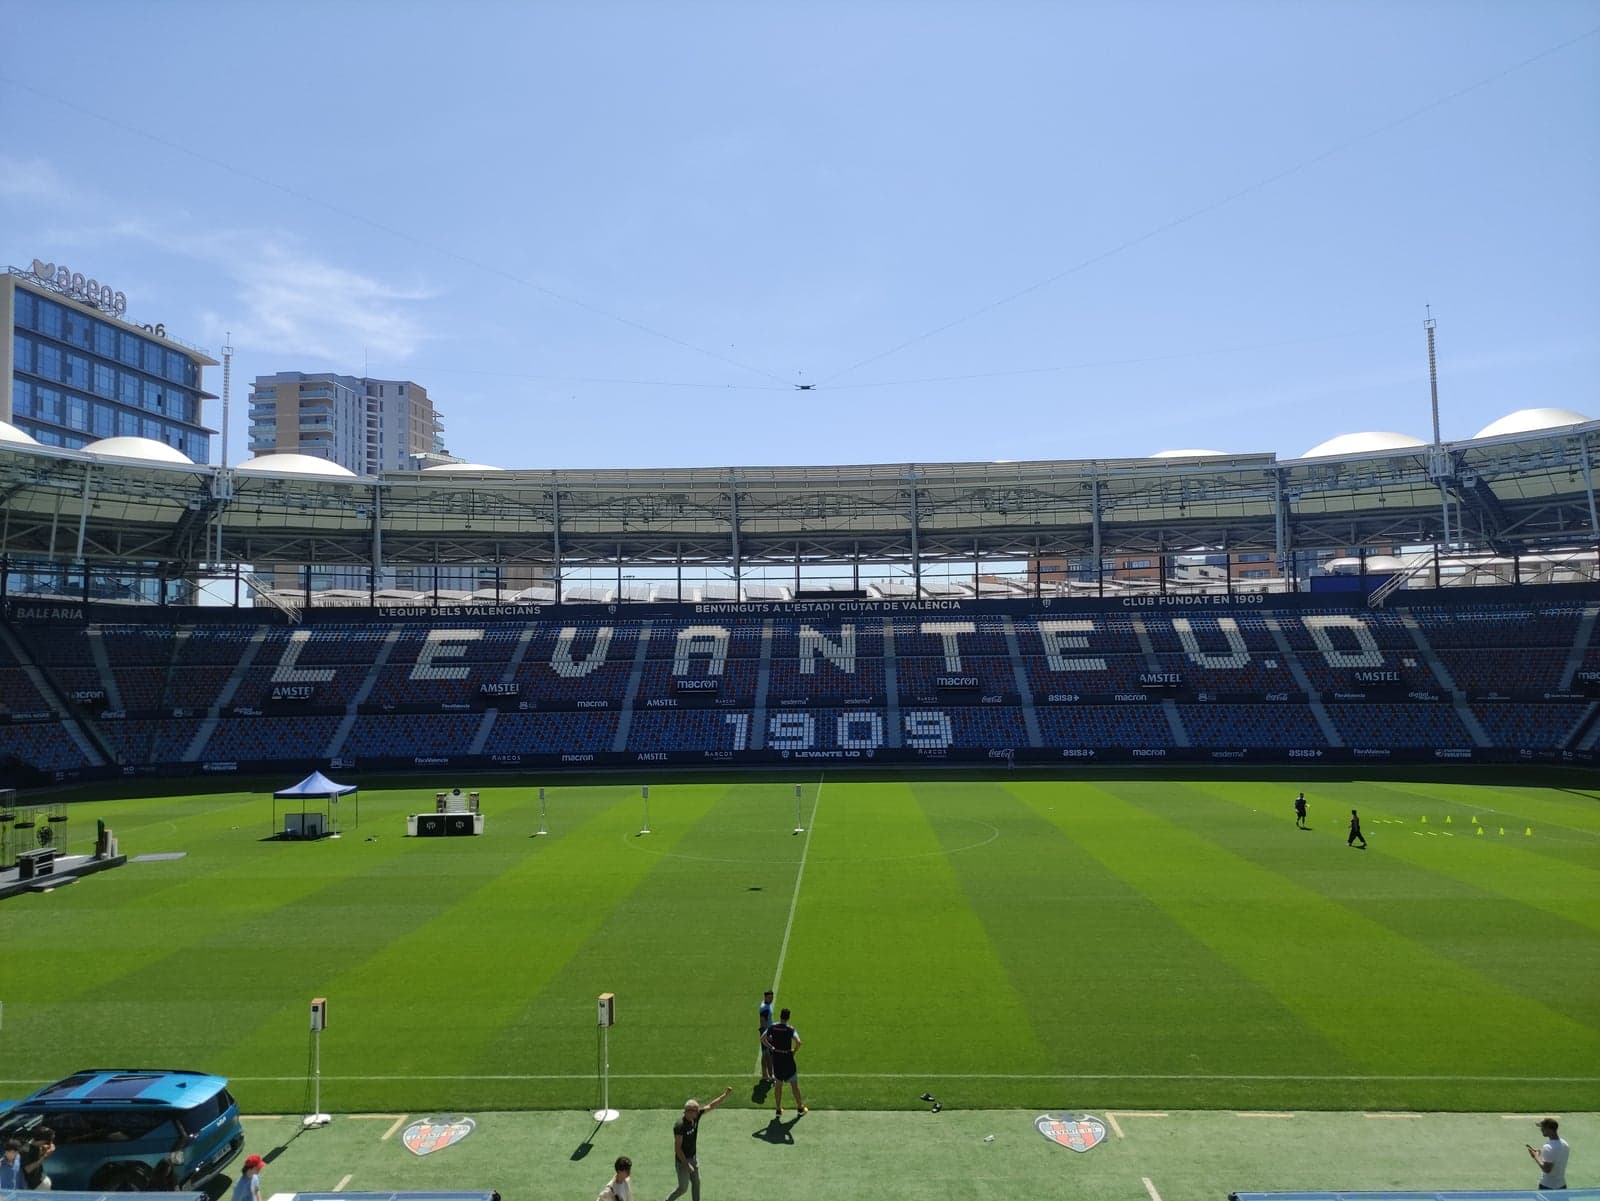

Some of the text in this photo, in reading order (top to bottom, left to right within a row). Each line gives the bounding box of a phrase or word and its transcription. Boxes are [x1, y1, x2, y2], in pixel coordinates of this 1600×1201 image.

[1123, 594, 1264, 607] CLUB FUNDAT EN 1909
[379, 606, 541, 617] L'EQUIP DELS VALENCIANS
[695, 604, 769, 614] BENVINGUTS
[773, 604, 781, 612] A
[784, 603, 835, 612] L'ESTADI
[839, 602, 880, 612] CIUTAT
[883, 602, 898, 611] DE
[1139, 673, 1182, 683] AMSTEL
[1355, 671, 1400, 681] AMSTEL
[677, 680, 718, 689] macron
[936, 677, 979, 687] macron
[1114, 694, 1147, 702] macron
[577, 700, 608, 708] macron
[646, 699, 678, 707] AMSTEL
[561, 753, 594, 762] macron
[637, 753, 668, 761] AMSTEL
[1132, 749, 1166, 757] macron
